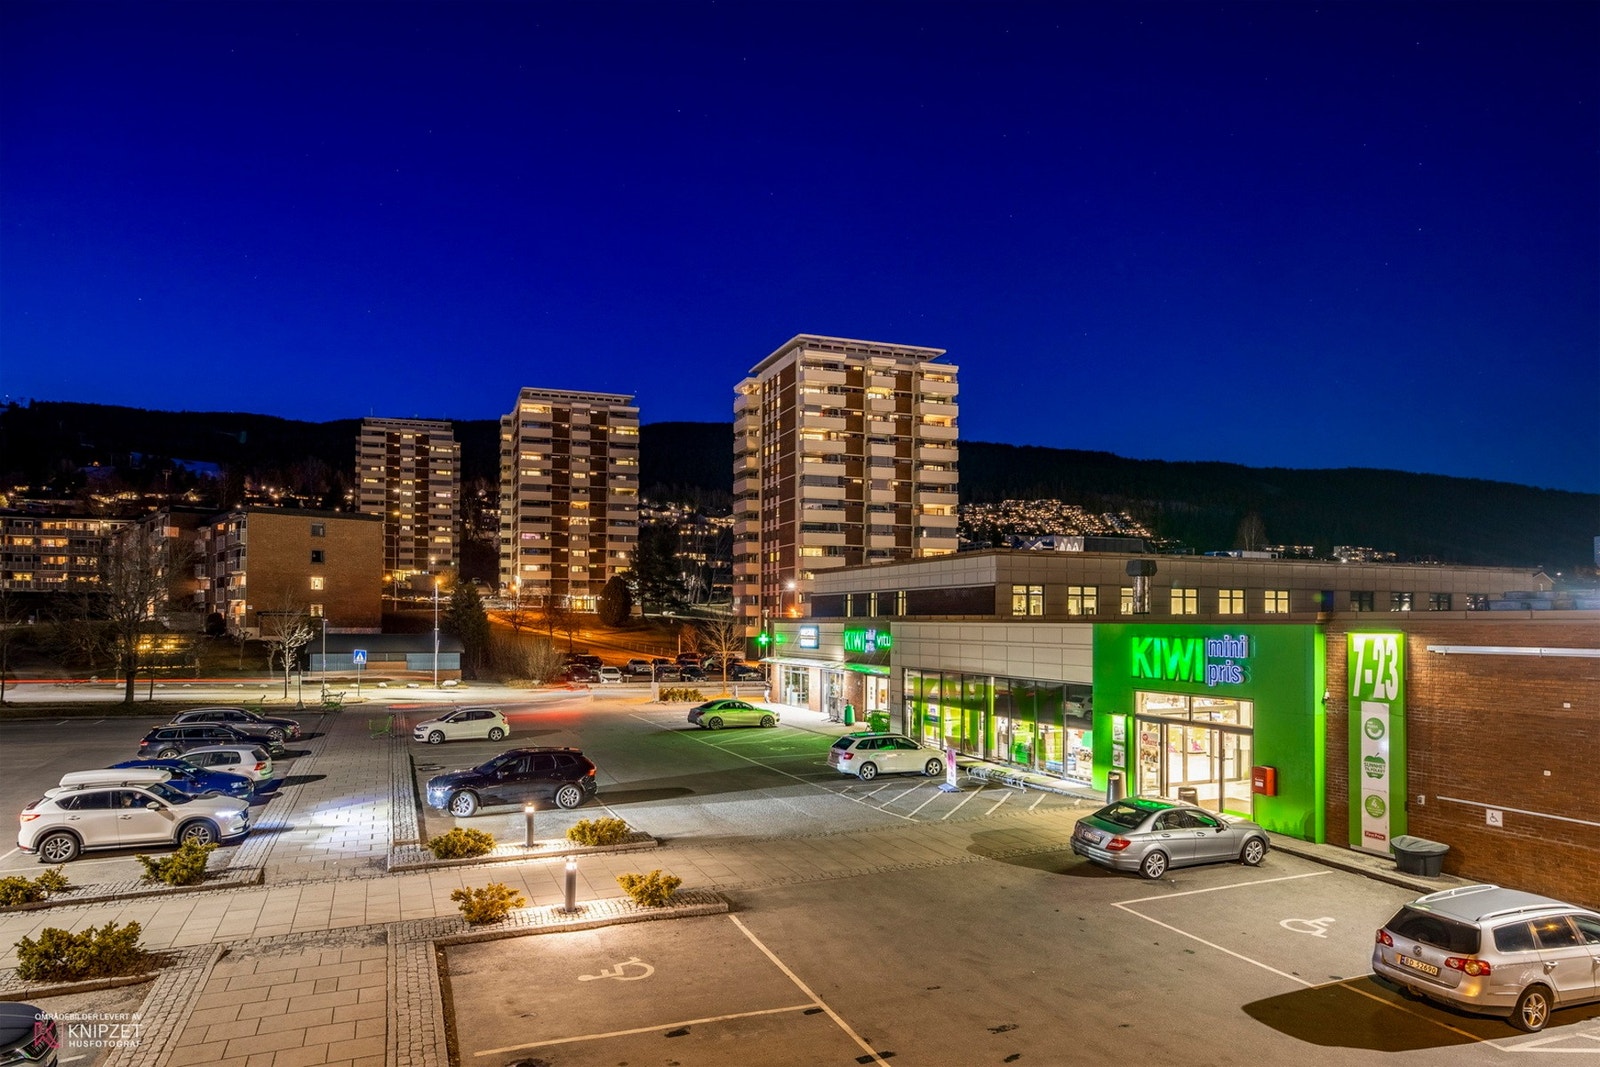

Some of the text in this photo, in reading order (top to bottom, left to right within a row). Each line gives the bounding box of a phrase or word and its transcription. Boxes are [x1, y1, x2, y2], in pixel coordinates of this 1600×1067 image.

[845, 631, 864, 650] KIWI
[1208, 634, 1247, 659] mini
[1132, 636, 1203, 682] KIWI
[1208, 659, 1244, 687] pris
[1353, 635, 1399, 701] 7-23
